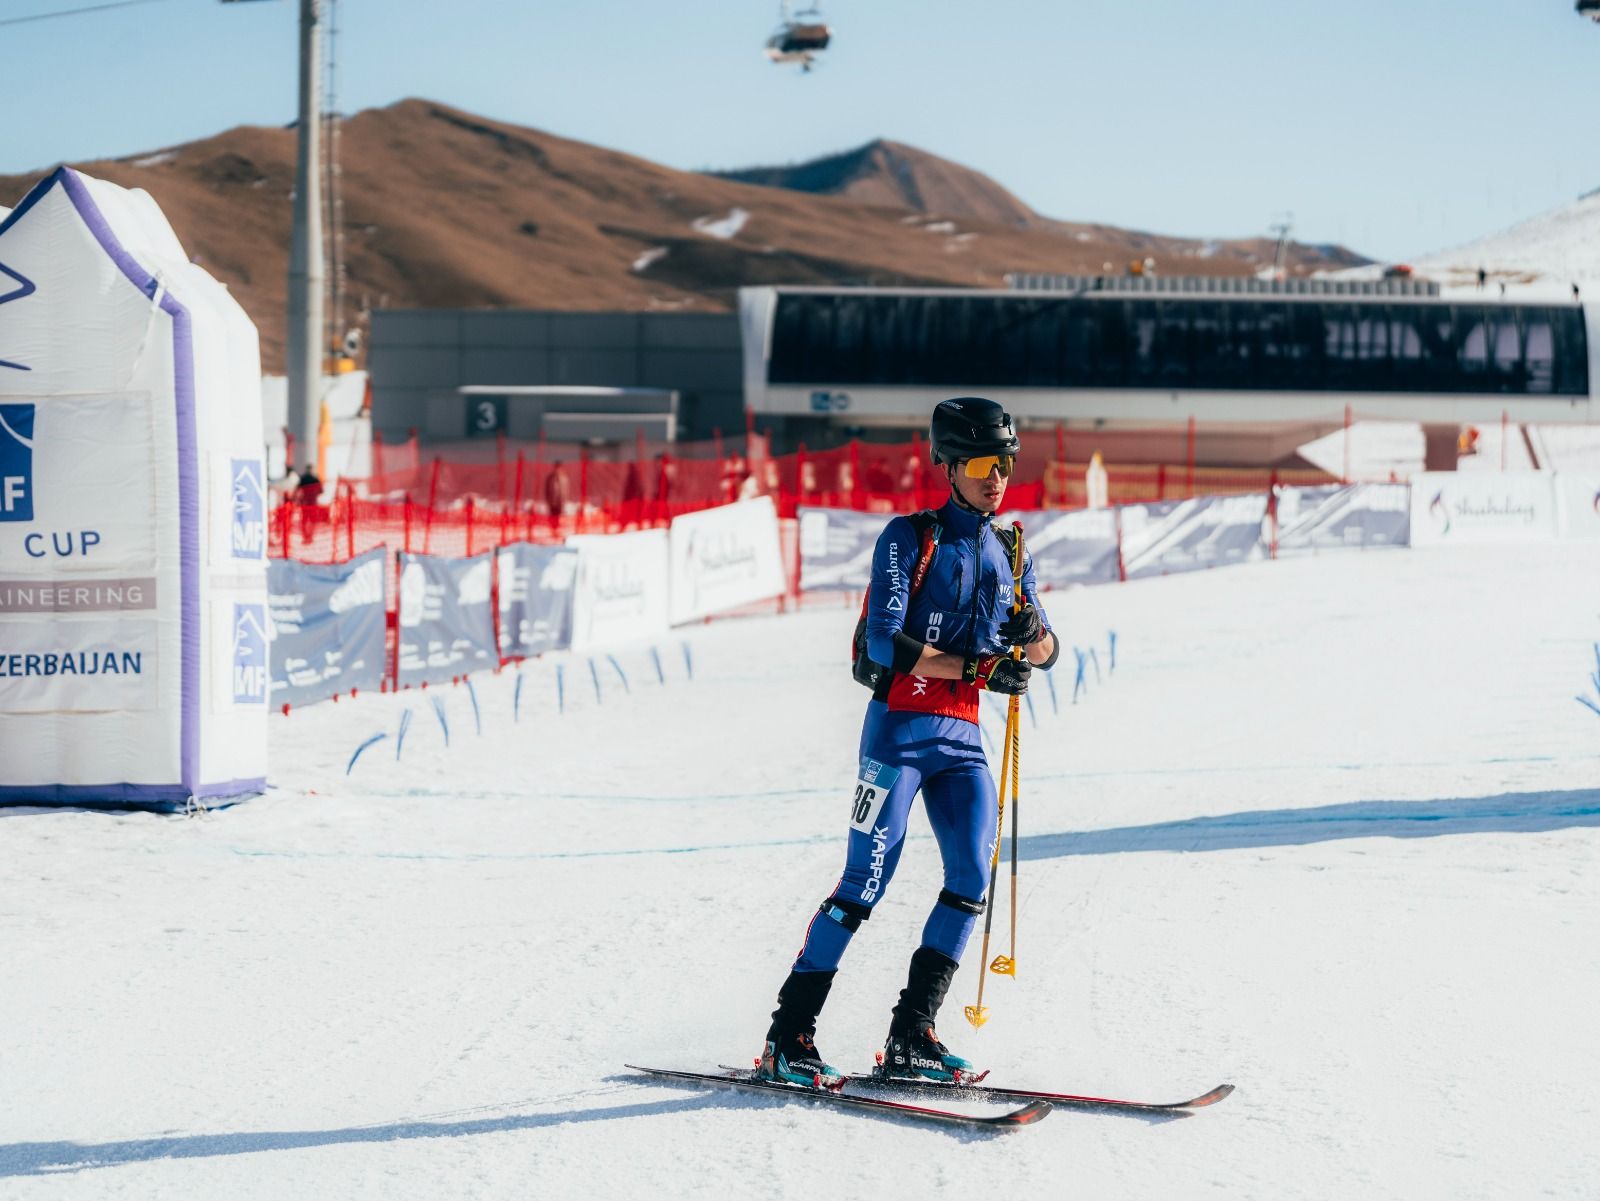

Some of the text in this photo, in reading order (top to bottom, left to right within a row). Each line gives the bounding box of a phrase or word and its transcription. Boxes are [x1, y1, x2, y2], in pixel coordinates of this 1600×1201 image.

[477, 402, 496, 430] 3
[24, 531, 100, 558] CUP
[886, 542, 902, 596] Andorra
[851, 784, 876, 824] 36
[860, 825, 889, 903] KARPOS
[788, 1061, 821, 1074] SCARPA
